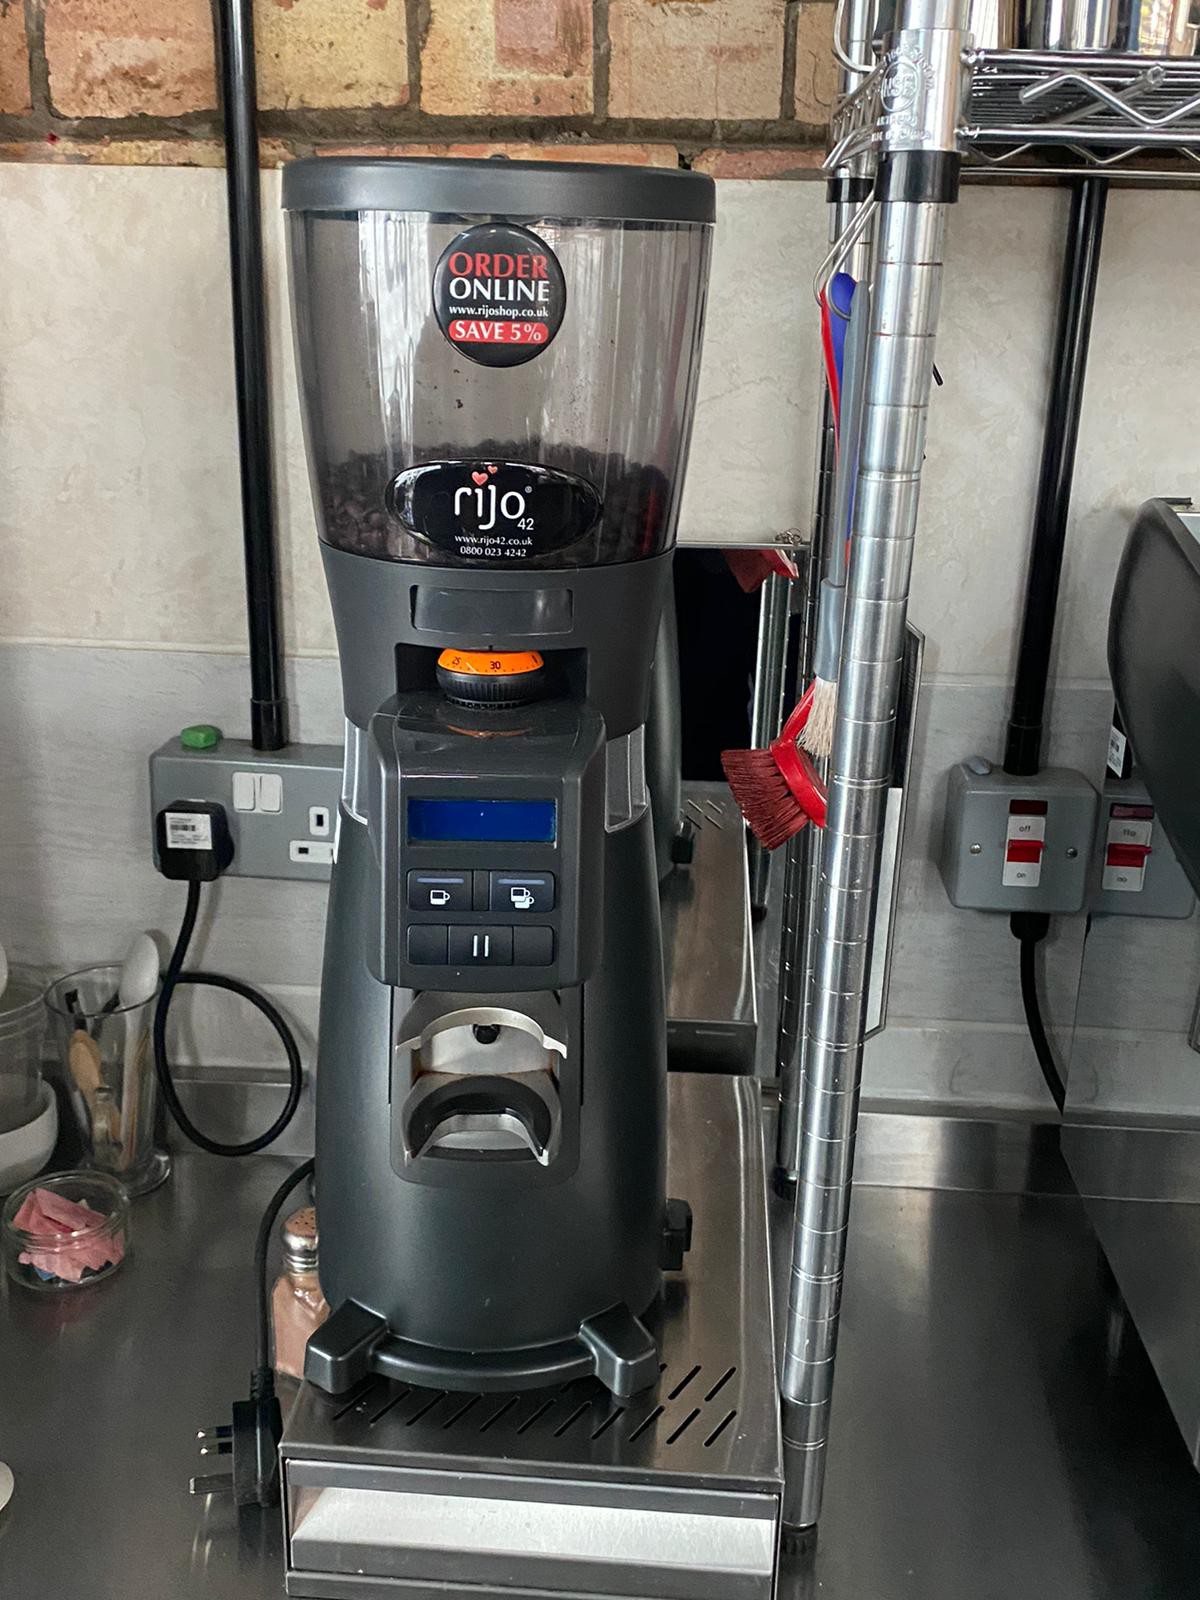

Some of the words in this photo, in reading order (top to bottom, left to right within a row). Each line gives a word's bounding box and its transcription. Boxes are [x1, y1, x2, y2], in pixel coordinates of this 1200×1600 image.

[449, 252, 548, 278] ORDER
[449, 277, 549, 301] ONLINE
[449, 305, 548, 318] www.rijoshop.co.uk
[455, 320, 504, 340] SAVE
[510, 323, 542, 341] 5%
[454, 484, 525, 530] rijo
[517, 518, 534, 531] 42
[454, 535, 533, 546] www.rijo42.co.uk
[460, 546, 483, 556] 0800
[484, 547, 502, 557] 023
[504, 548, 527, 557] 4242
[489, 660, 501, 670] 30
[1019, 825, 1031, 833] off
